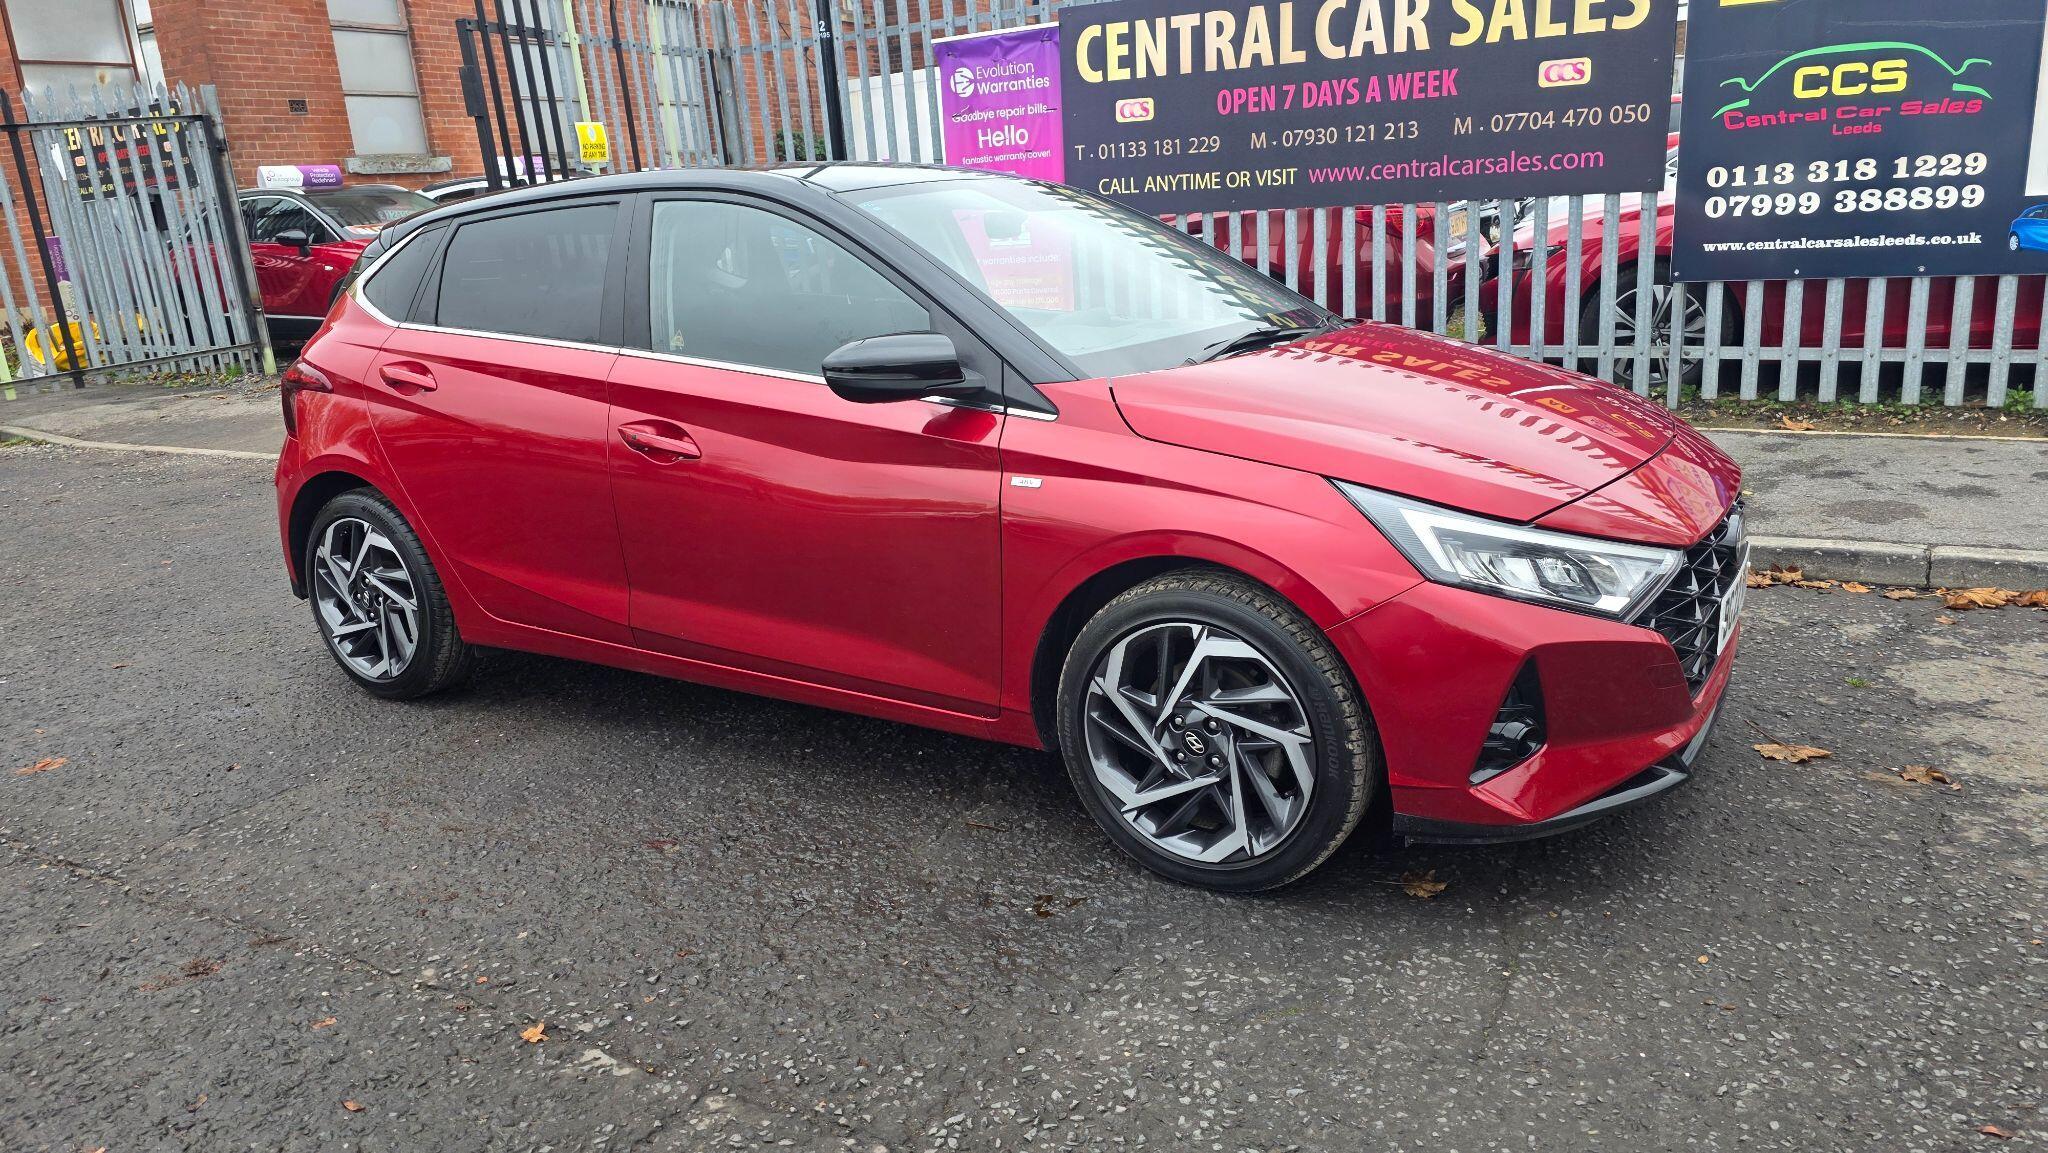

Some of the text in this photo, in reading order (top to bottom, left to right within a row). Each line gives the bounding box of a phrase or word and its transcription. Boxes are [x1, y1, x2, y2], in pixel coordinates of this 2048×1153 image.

[819, 20, 826, 31] 2
[1076, 2, 1307, 83] CENTRAL
[1315, 0, 1430, 60] CAR
[976, 61, 1035, 79] Evolution
[1544, 61, 1586, 83] CCS
[1793, 59, 1908, 99] CCS
[977, 75, 1050, 95] Warranties
[1217, 68, 1459, 115] OPEN 7 DAYS A WEEK
[952, 109, 995, 123] Goodbye
[996, 105, 1026, 120] repair
[1119, 101, 1150, 119] CCS
[1491, 111, 1556, 133] 07704
[1561, 106, 1603, 128] 470
[1609, 103, 1651, 124] 050
[1723, 97, 1983, 131] Central Car Sales
[977, 124, 1029, 149] Hello
[1282, 127, 1338, 147] 07930
[1344, 124, 1375, 143] 121
[1384, 120, 1419, 140] 213
[1832, 122, 1882, 136] Leeds
[962, 155, 993, 165] fantastic
[993, 151, 1026, 162] warranty
[1098, 141, 1147, 160] 01133
[1153, 139, 1181, 156] 181
[1188, 136, 1221, 153] 229
[1098, 150, 1605, 195] CALL ANYTIME OR VISIT www.centralcarsales.com
[1706, 152, 1988, 188] 0113 318 1229
[1704, 184, 1986, 219] 07999 388899
[1703, 232, 1982, 252] www.centralcarsalesleeds.co.uk
